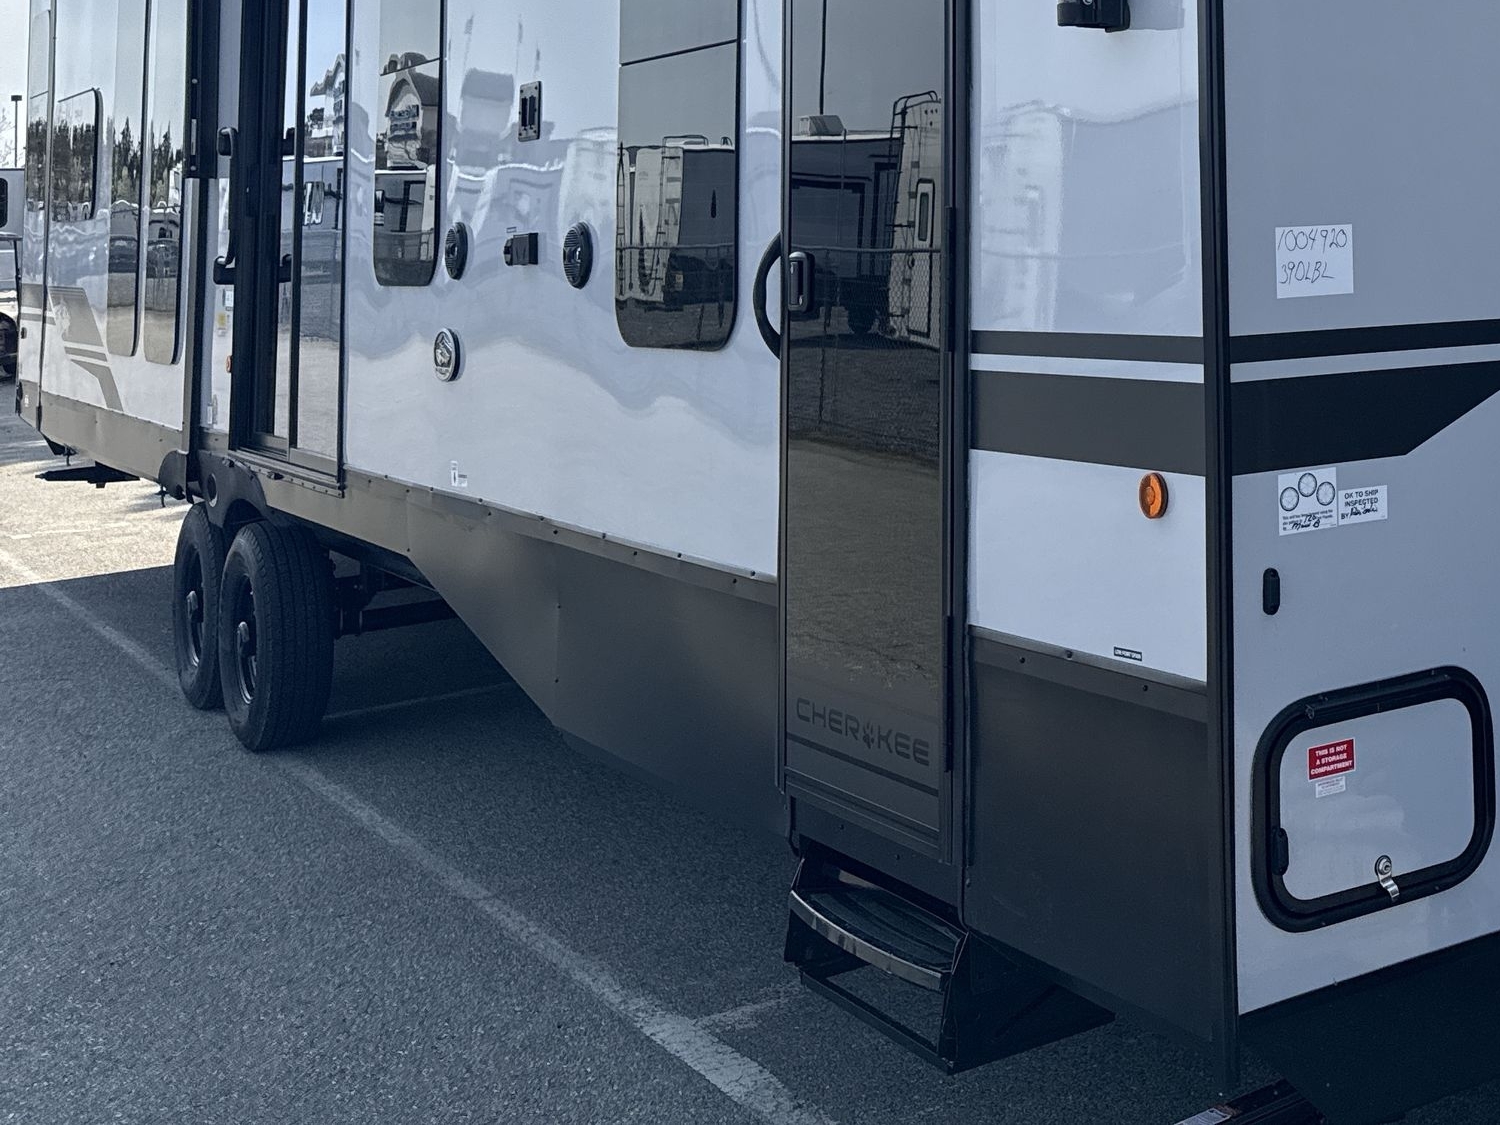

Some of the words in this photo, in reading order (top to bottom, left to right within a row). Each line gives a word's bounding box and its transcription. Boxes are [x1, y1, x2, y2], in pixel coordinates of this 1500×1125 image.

[1278, 228, 1348, 254] 1004920
[1344, 492, 1354, 500] OK
[1364, 489, 1379, 497] SHIP
[1344, 497, 1379, 507] INSPECTED
[1315, 748, 1328, 757] THIS
[1321, 753, 1347, 764] STORAGE
[1311, 760, 1353, 775] COMPARTMENT
